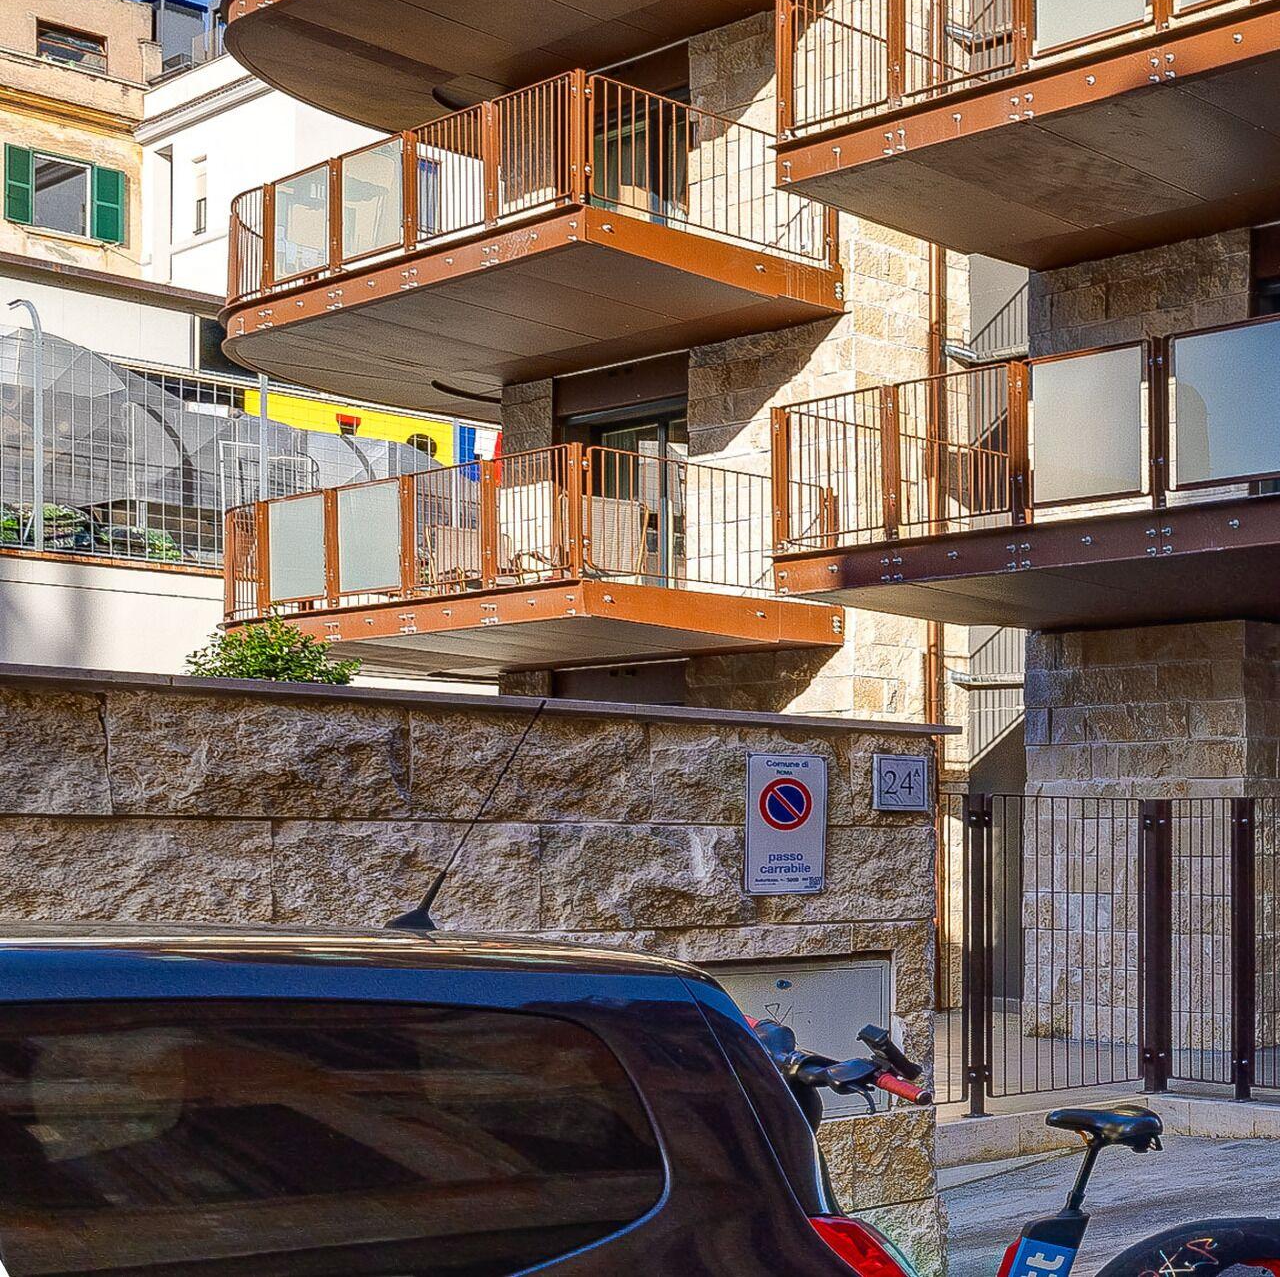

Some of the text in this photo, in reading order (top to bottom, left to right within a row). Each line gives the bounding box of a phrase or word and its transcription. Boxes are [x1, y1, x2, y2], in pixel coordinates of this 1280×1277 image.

[765, 759, 800, 768] Comune
[768, 853, 803, 864] passo
[760, 863, 811, 874] carrabile
